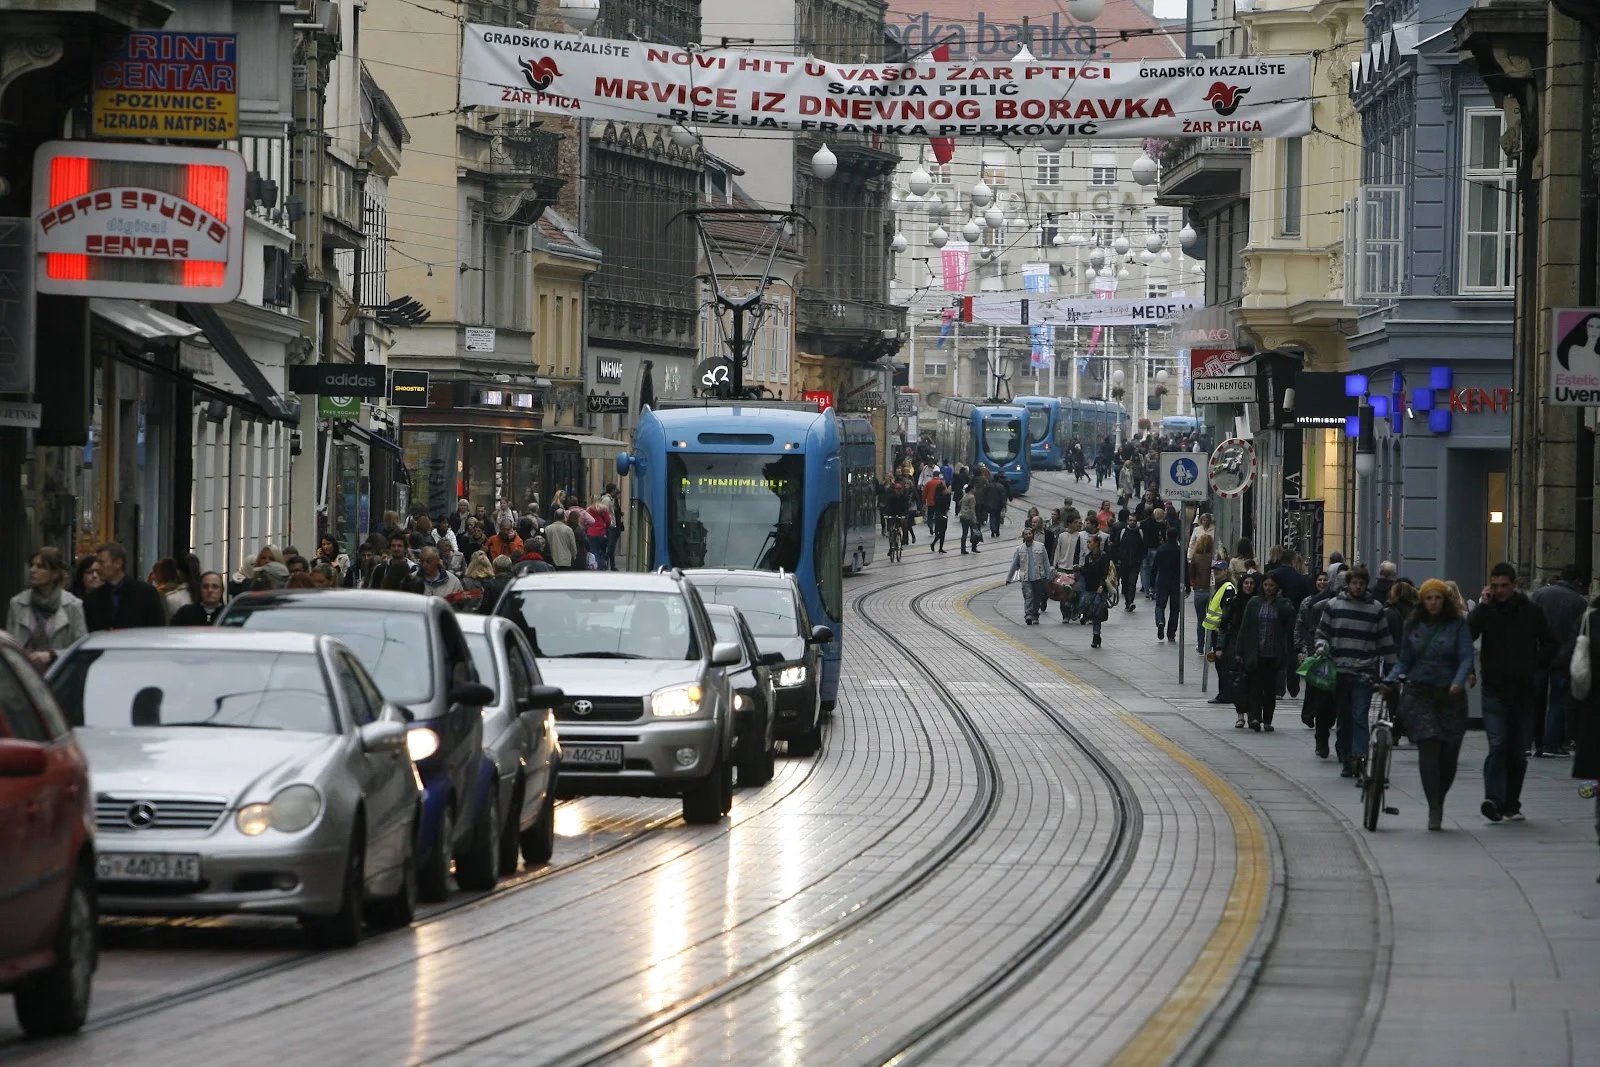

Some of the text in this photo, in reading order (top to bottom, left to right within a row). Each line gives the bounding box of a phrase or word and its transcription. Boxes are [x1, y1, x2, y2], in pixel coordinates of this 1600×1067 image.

[483, 31, 630, 58] GRADSKO KAZALIŠTE
[977, 11, 1097, 56] banka
[128, 34, 234, 60] RINT
[647, 48, 1112, 81] NOVI HIT U VAŠOJ ŽAR PTICI
[1139, 62, 1286, 78] GRADSKO KAZALIŠTE
[102, 61, 235, 91] CENTAR
[501, 87, 581, 111] ŽAR PTICA
[595, 77, 1176, 120] MRVICE IZ DNEVNOG BORAVKA
[828, 80, 1020, 97] SANJA PILIĆ
[115, 93, 217, 110] POZIVNICE
[103, 112, 227, 133] IZRADA NATPISA
[802, 120, 936, 136] FRANKA
[939, 119, 1099, 137] PERKOVIĆ
[1182, 118, 1263, 133] ŽAR PTICA
[40, 191, 226, 243] FOTO STUDIO
[106, 216, 168, 235] digital
[86, 235, 189, 258] CENTAR
[325, 373, 376, 387] adidas
[1196, 381, 1253, 391] ZUBNI RENTGEN
[591, 397, 625, 407] VINCEK
[1450, 388, 1511, 413] KENT
